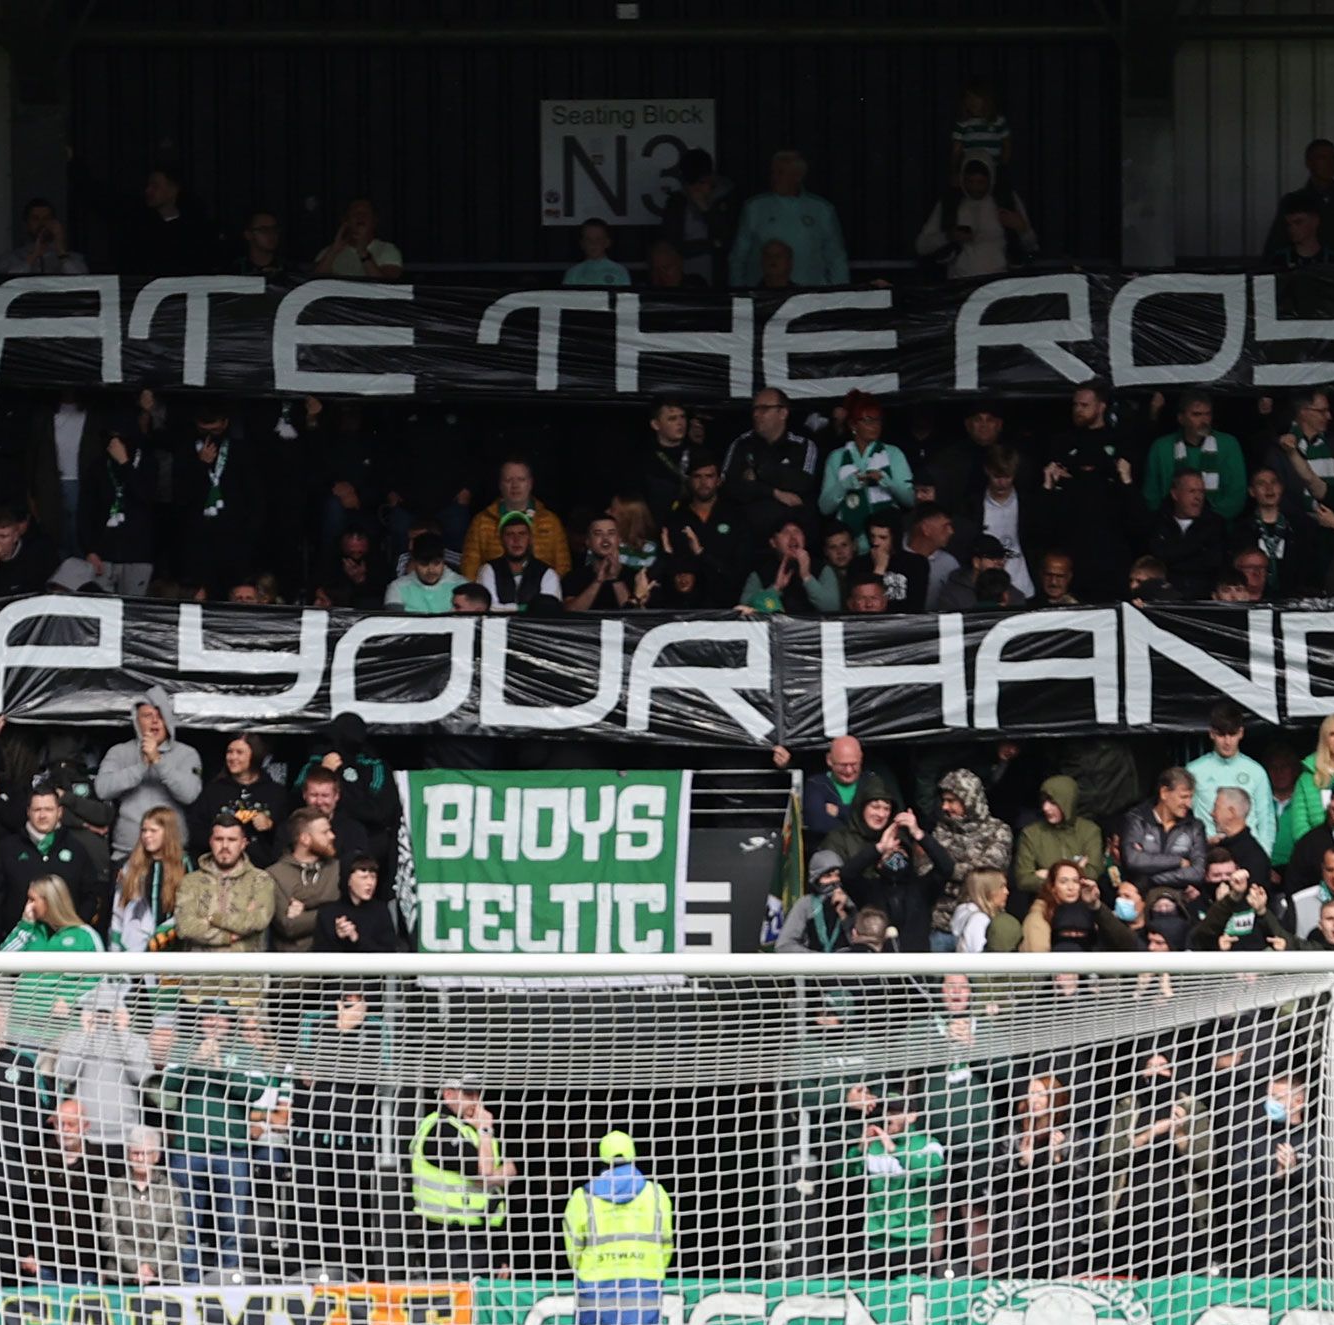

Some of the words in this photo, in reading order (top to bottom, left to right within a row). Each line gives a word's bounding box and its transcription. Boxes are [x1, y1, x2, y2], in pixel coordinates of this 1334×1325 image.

[552, 104, 635, 129] Seating
[643, 104, 703, 125] Block
[563, 134, 690, 218] N3
[476, 289, 902, 398] THE
[172, 603, 775, 740] YOUR
[422, 783, 667, 862] BHOYS
[417, 882, 667, 954] CELTIC
